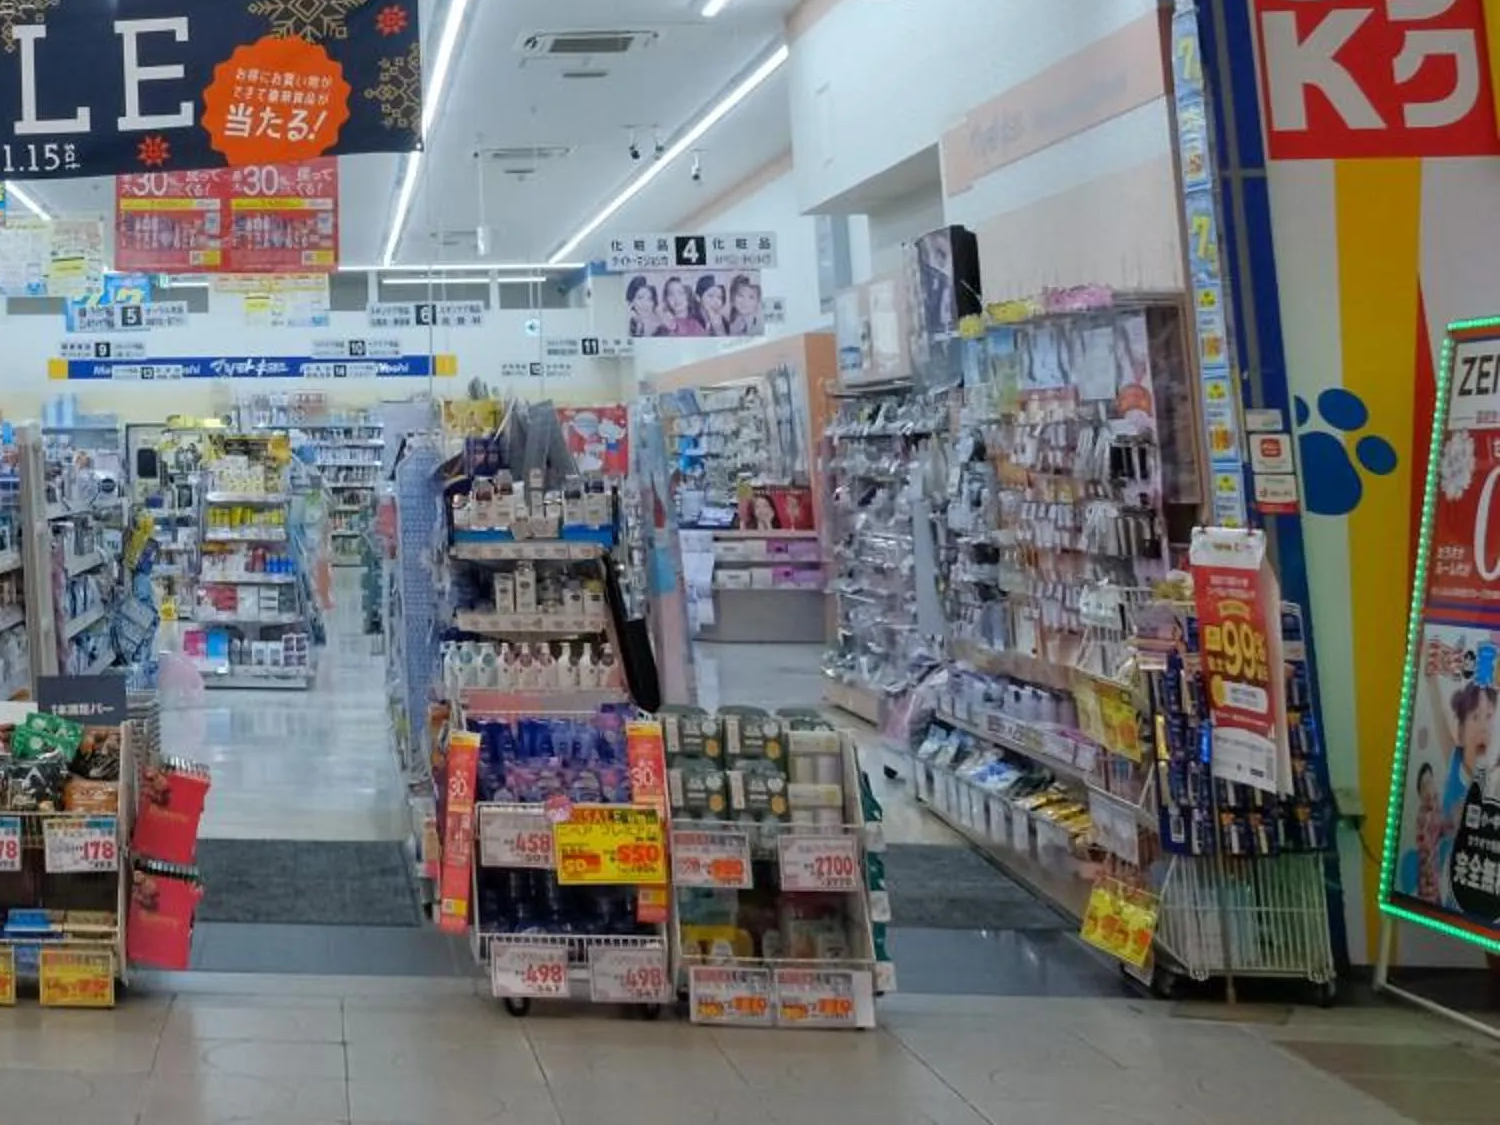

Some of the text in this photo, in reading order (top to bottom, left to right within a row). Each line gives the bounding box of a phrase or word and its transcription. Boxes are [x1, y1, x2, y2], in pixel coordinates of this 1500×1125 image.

[223, 103, 328, 142] 当たる!
[681, 238, 699, 263] 4
[82, 840, 115, 860] 178
[526, 963, 563, 984] 498
